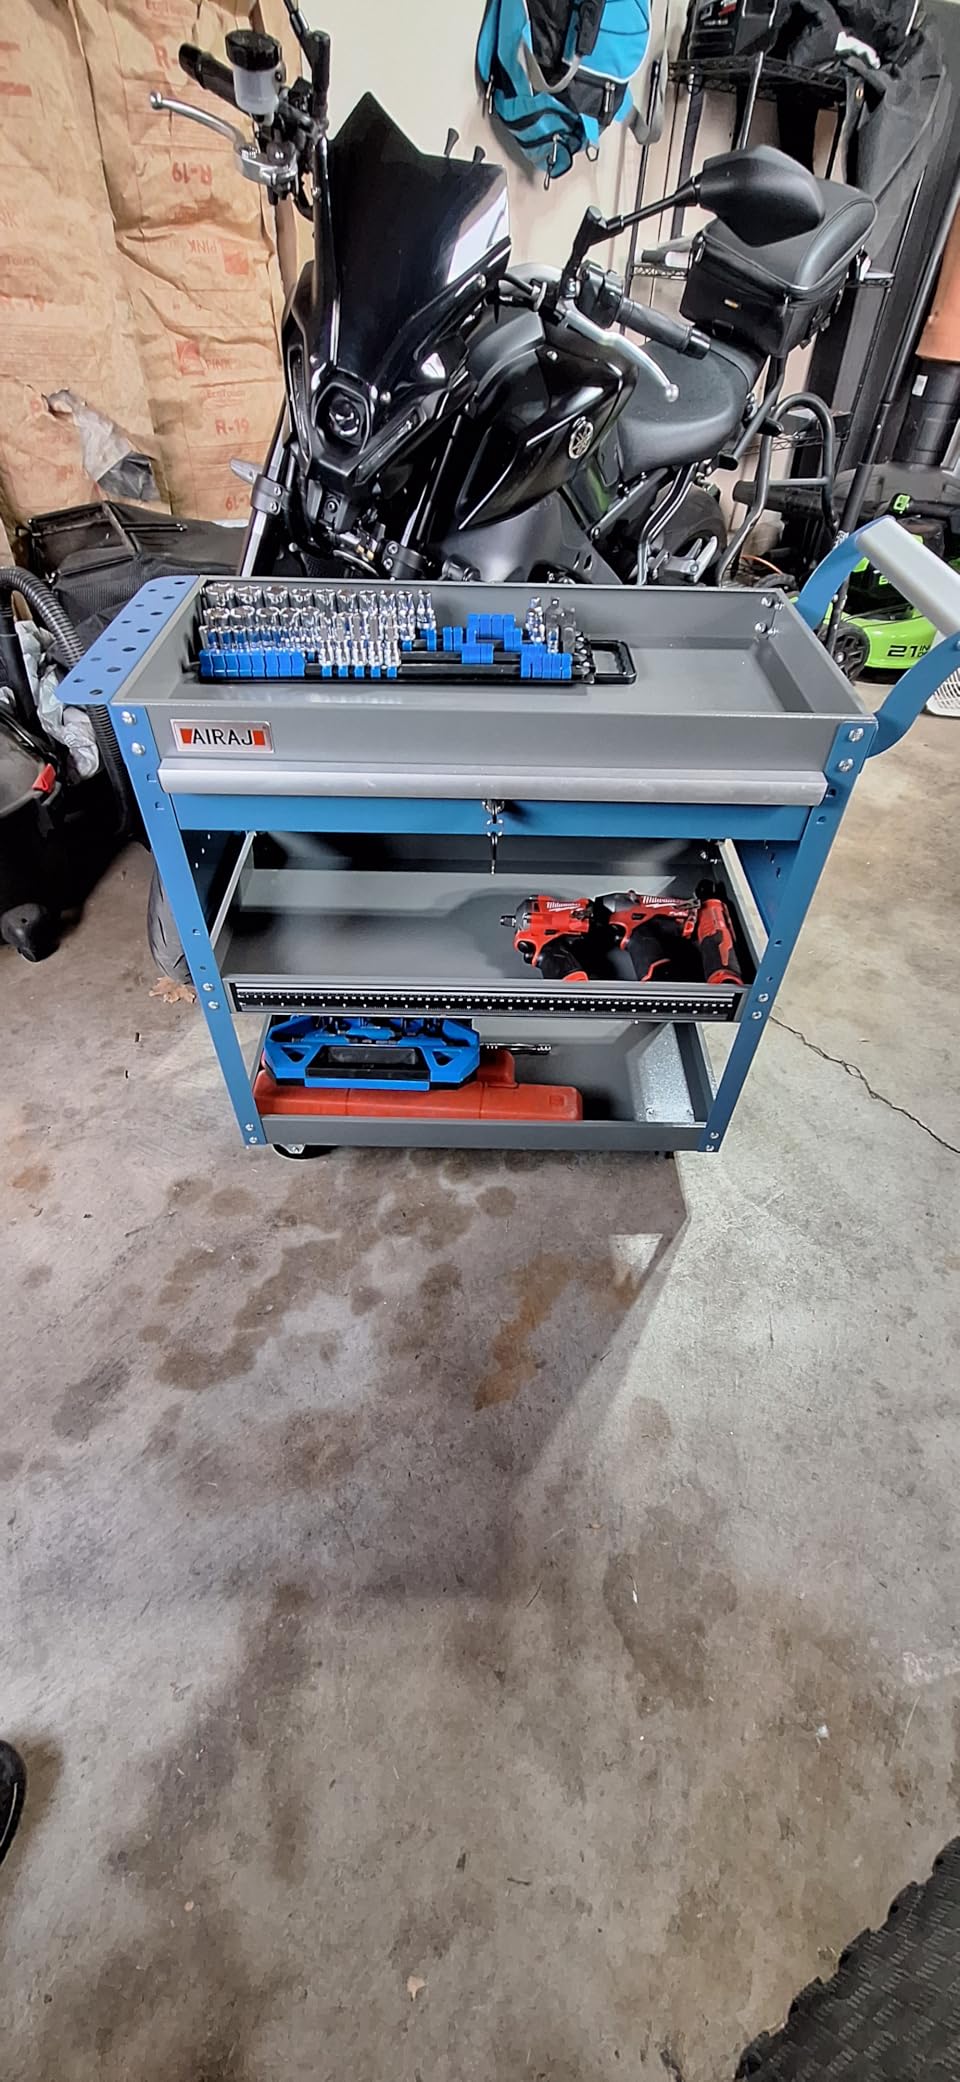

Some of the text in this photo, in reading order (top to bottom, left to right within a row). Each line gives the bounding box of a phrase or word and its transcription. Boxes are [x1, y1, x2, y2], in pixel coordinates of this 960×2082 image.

[171, 161, 213, 186] R-19
[215, 418, 249, 434] R-19
[887, 644, 918, 658] 21
[193, 728, 253, 746] AIRAJ
